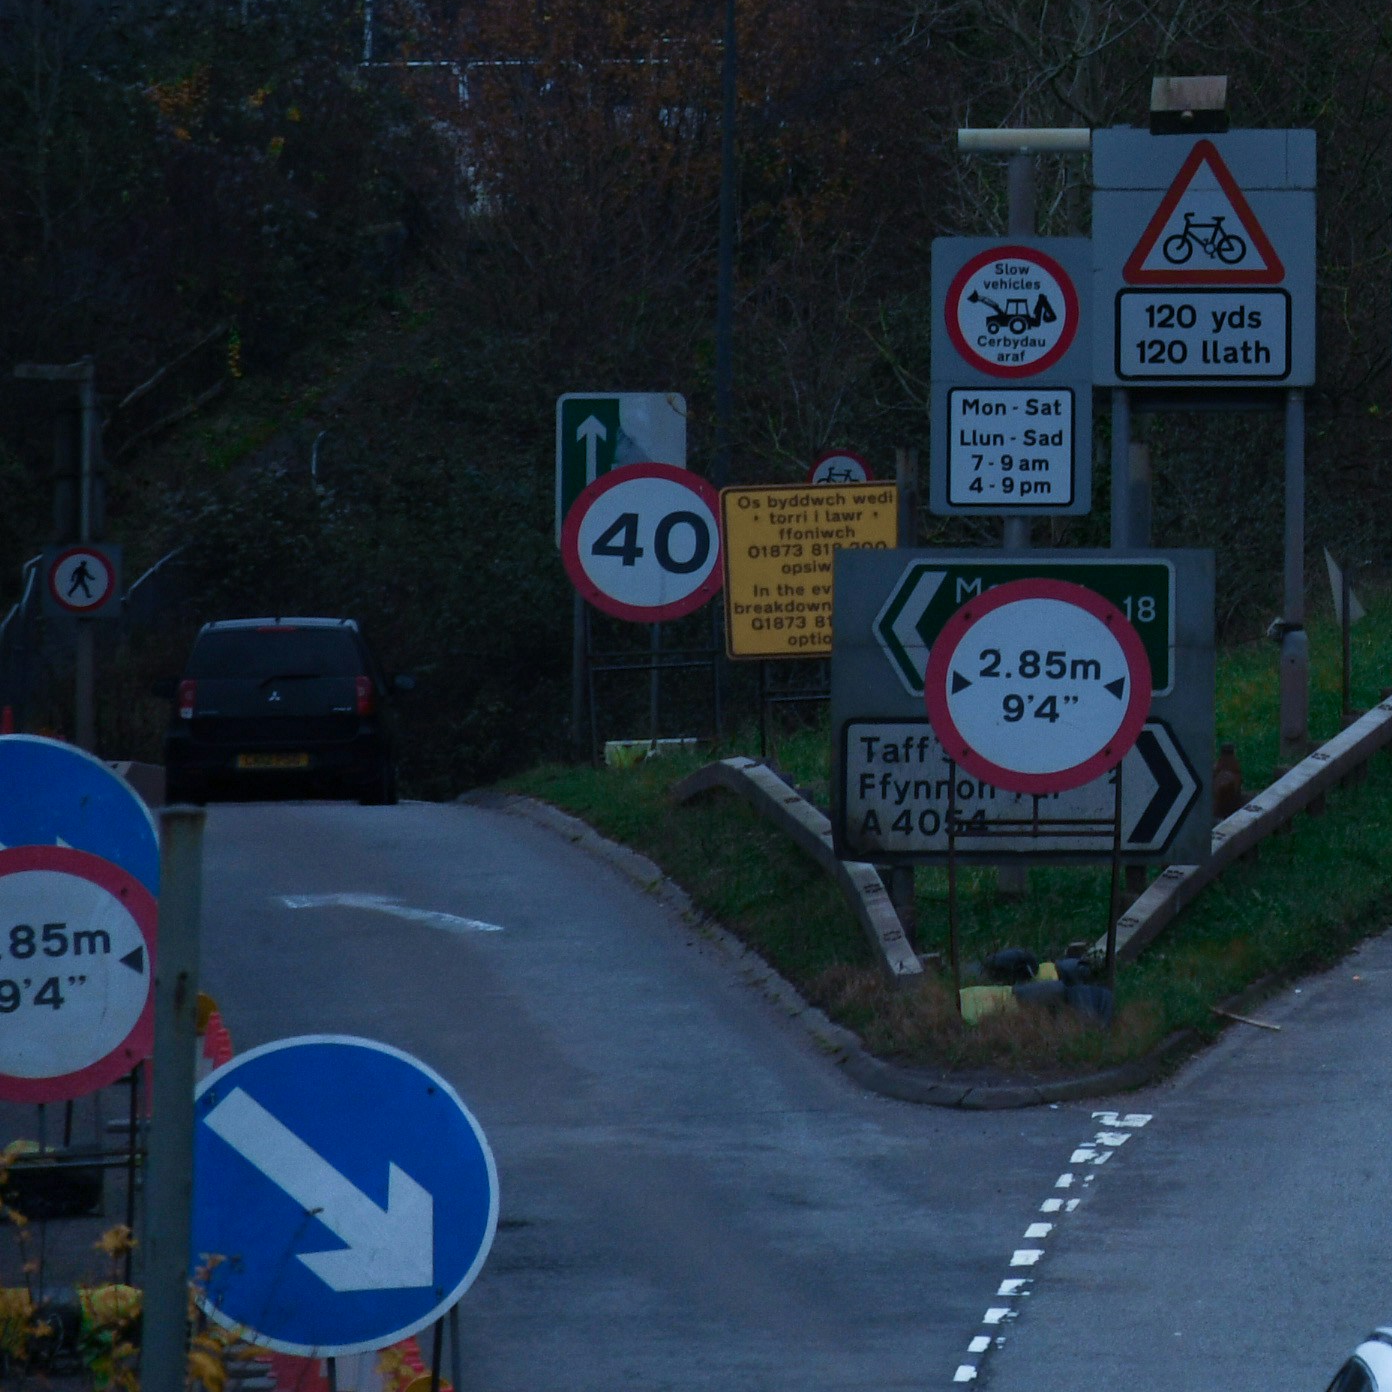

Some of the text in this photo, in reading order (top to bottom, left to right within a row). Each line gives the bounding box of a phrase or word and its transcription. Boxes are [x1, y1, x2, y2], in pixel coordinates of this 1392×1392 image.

[995, 263, 1030, 275] Slow
[983, 278, 1040, 289] vehicles
[1145, 304, 1262, 333] 120 yds
[977, 336, 1046, 349] Cerbydau
[997, 350, 1025, 361] araf
[1136, 340, 1270, 364] 120 llath
[962, 398, 1006, 416] Mon
[1025, 398, 1062, 416] Sat
[960, 429, 1004, 446] Llun
[1023, 429, 1063, 446] Sad
[1019, 458, 1049, 471] am
[1020, 481, 1051, 497] pm
[737, 491, 893, 510] Os byddwch wedi
[769, 512, 807, 525] torri
[825, 510, 863, 523] lawr
[779, 526, 855, 541] ffoniwch
[591, 510, 710, 574] 40
[748, 544, 803, 559] 01873
[753, 584, 770, 598] In
[777, 583, 805, 597] the
[734, 600, 832, 615] breakdown
[1122, 595, 1156, 623] 18
[751, 616, 807, 631] 01873
[979, 648, 1101, 680] 2.85m
[1002, 694, 1079, 723] 9'4"
[859, 772, 995, 805] Ffynnon
